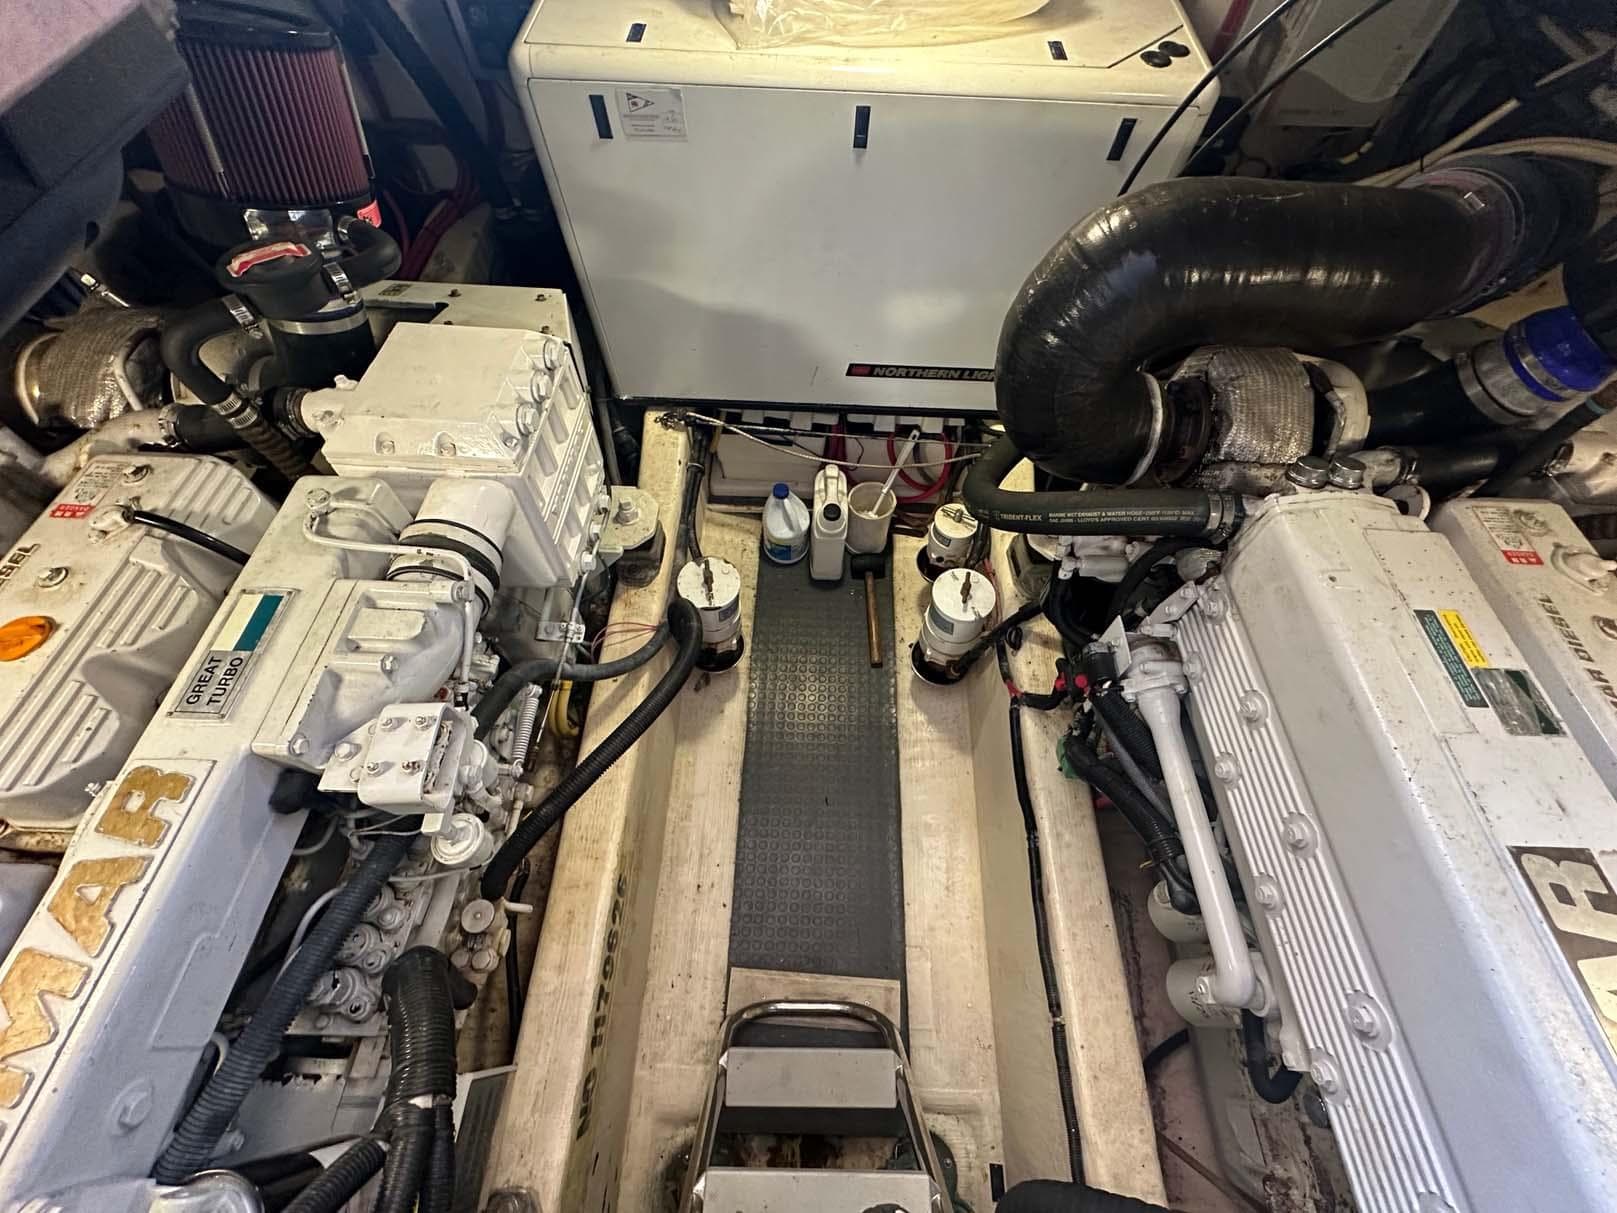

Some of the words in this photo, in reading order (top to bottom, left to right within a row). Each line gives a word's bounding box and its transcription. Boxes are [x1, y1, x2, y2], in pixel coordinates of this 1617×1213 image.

[873, 366, 960, 379] NORTHERN
[1000, 512, 1042, 521] TRIDENT-FLEX
[1537, 593, 1595, 663] DIESEL
[186, 655, 222, 705] GREAT
[206, 657, 244, 706] TURBO
